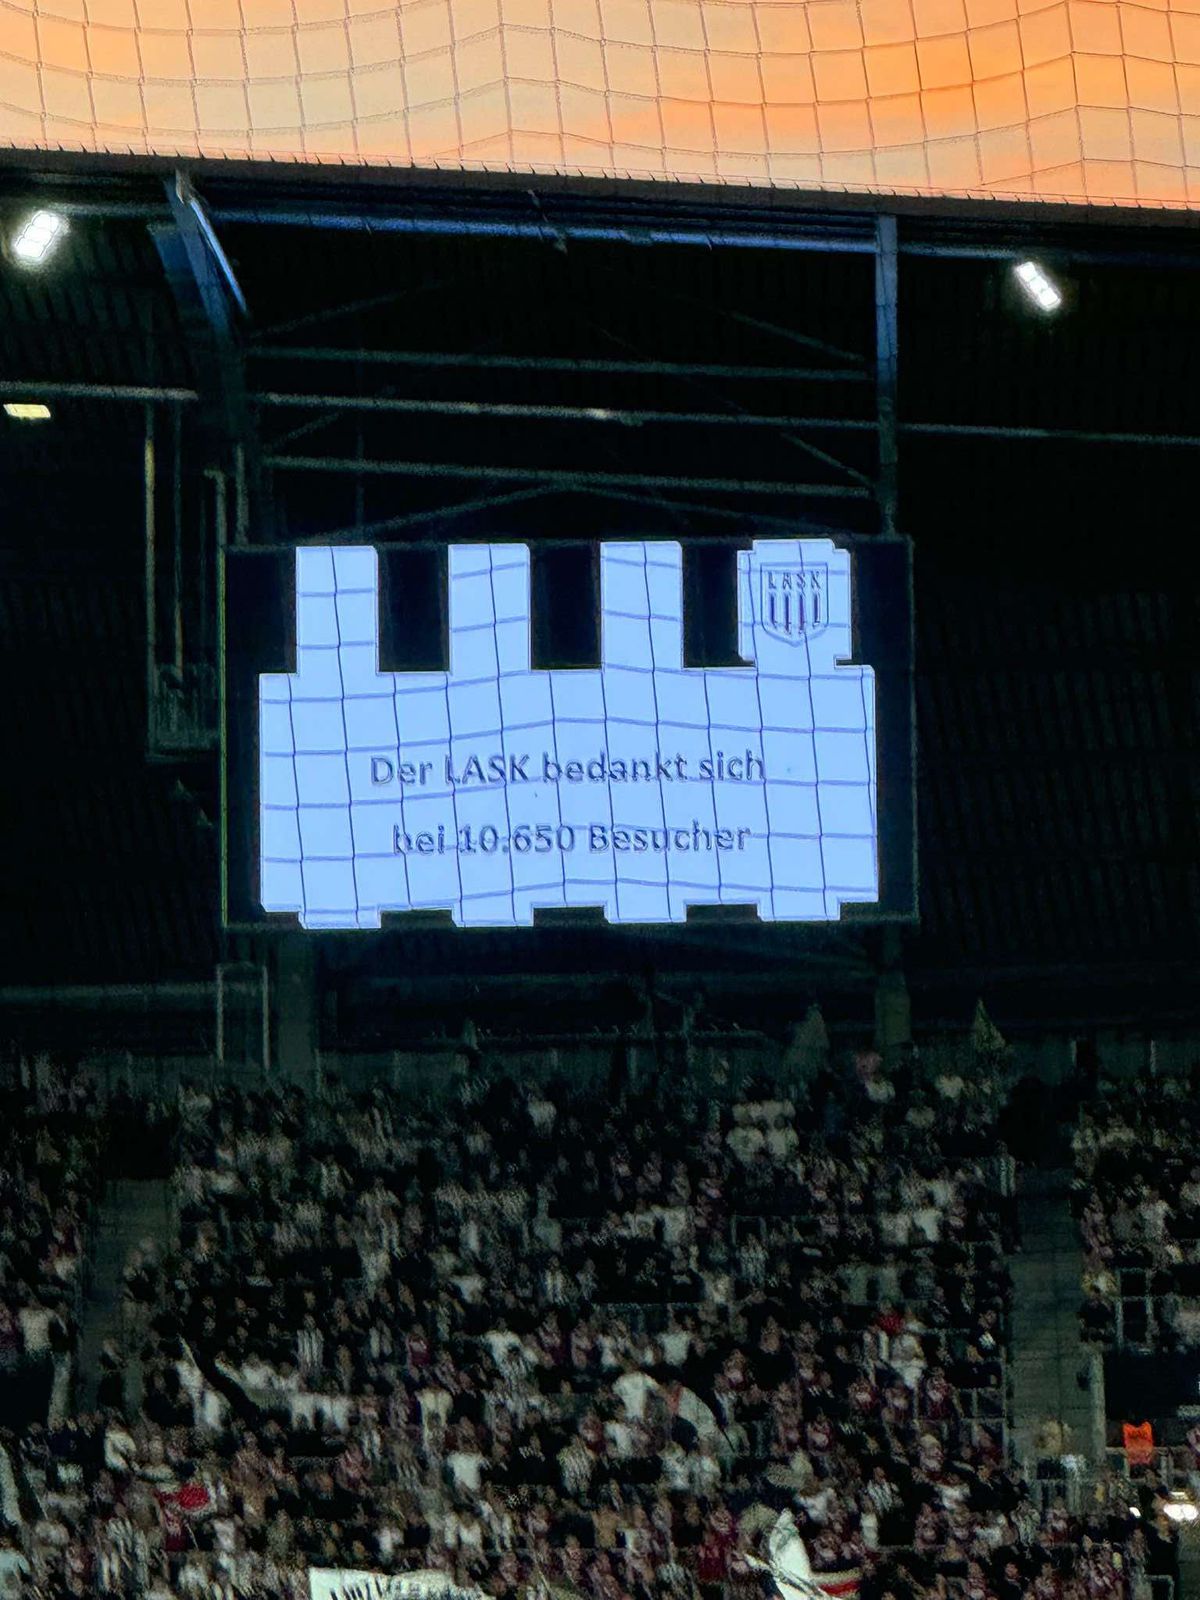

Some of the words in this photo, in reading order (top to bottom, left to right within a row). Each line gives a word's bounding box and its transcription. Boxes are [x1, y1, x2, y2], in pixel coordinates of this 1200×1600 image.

[371, 756, 433, 785] Der
[445, 754, 530, 784] LASK
[543, 750, 688, 782] bedankt
[700, 750, 765, 781] sich
[393, 824, 445, 855] bei
[458, 824, 576, 853] 10.650
[589, 818, 752, 852] Besucher
